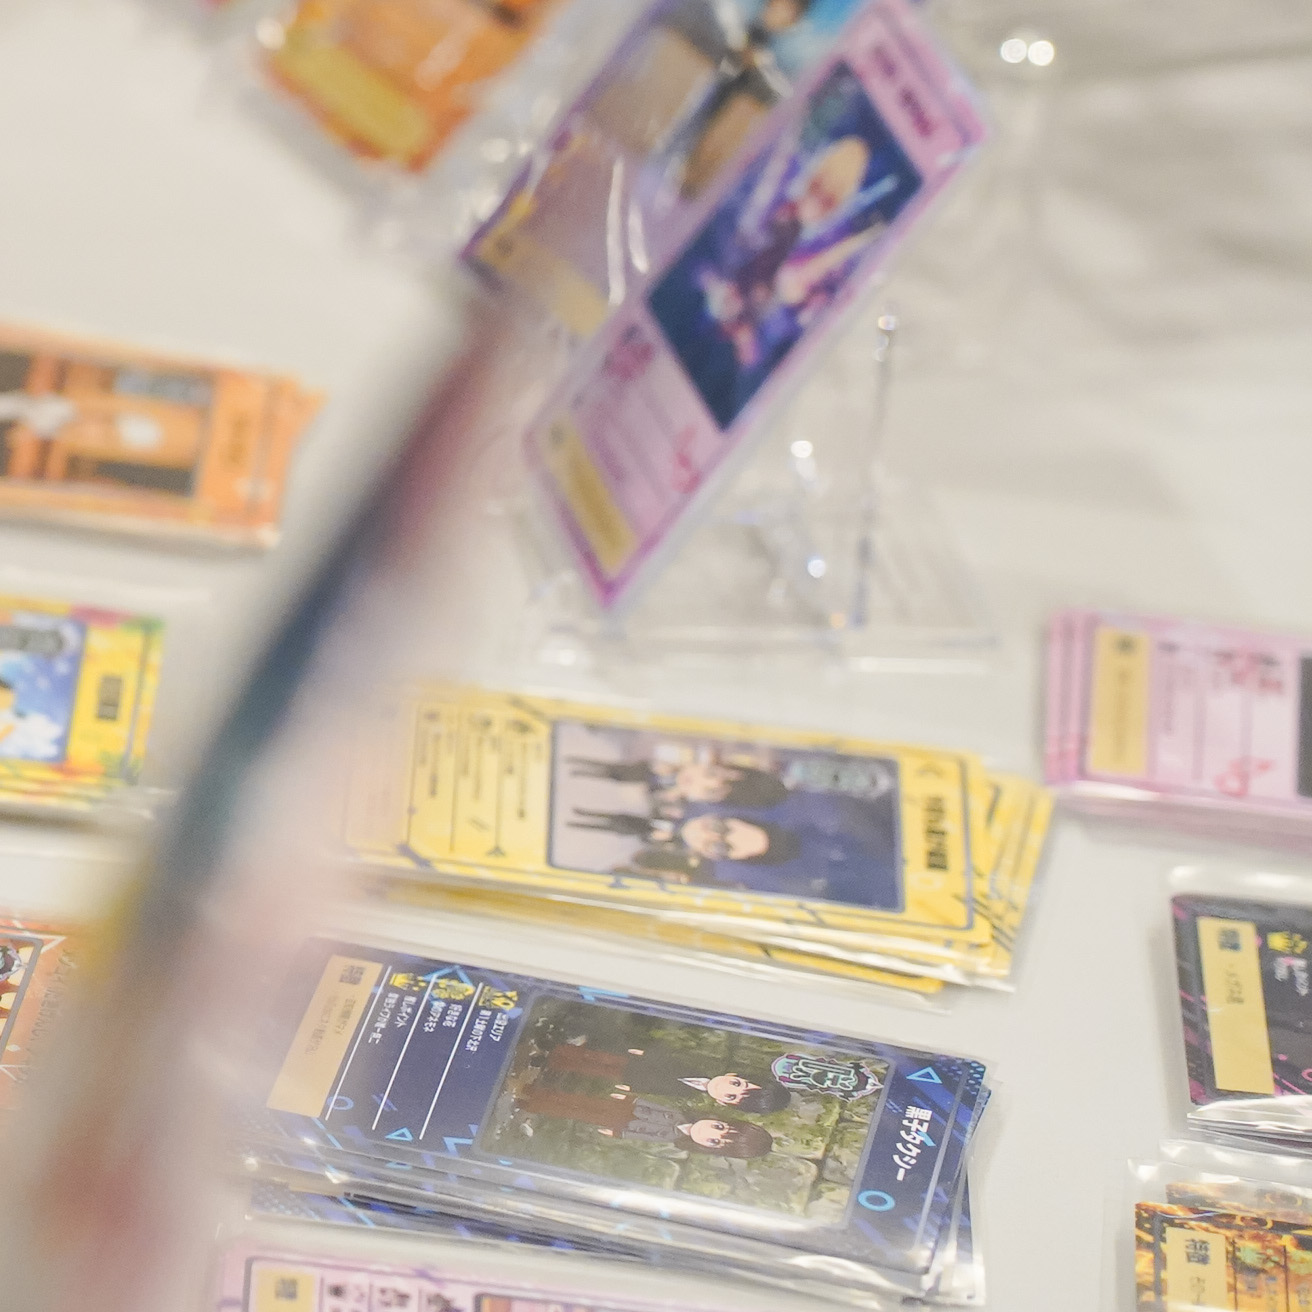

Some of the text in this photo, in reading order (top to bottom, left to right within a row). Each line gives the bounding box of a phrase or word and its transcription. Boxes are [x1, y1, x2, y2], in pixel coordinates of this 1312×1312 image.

[893, 1103, 934, 1182] 黒子タクシー
